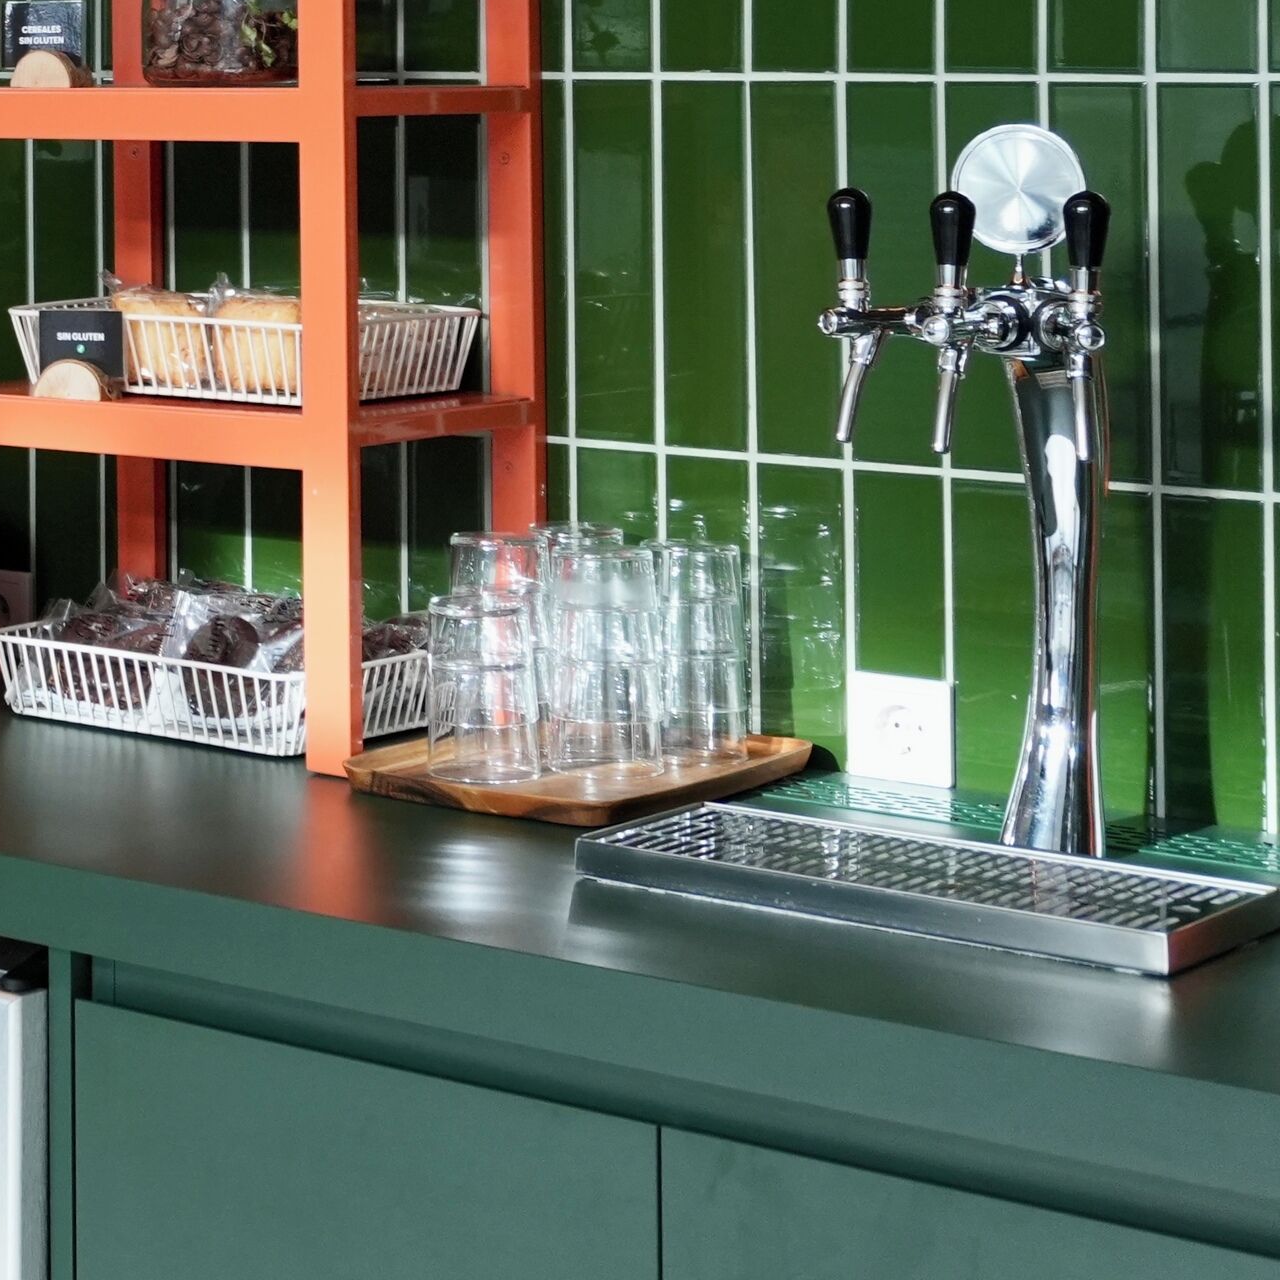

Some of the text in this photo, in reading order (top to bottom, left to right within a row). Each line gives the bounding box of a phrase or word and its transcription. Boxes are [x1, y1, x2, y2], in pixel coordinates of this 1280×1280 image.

[21, 25, 61, 34] CEREALES
[19, 36, 64, 45] SIN GLUTEN
[56, 332, 105, 342] SIN GLUTEN
